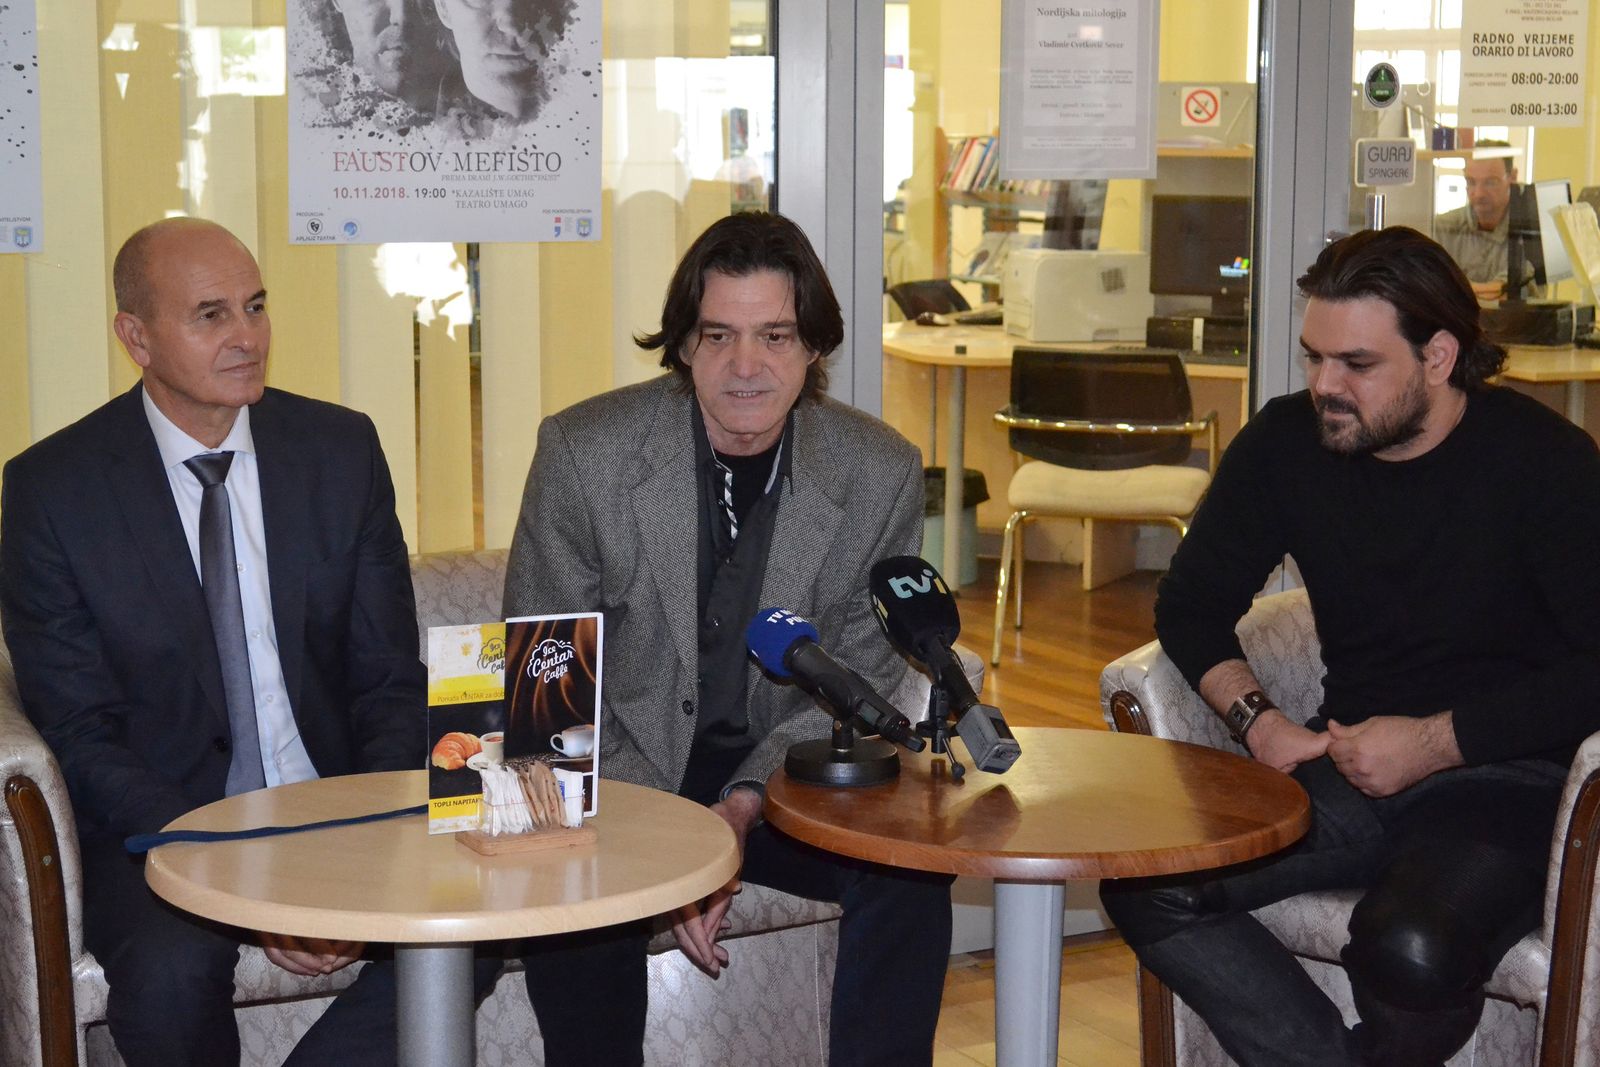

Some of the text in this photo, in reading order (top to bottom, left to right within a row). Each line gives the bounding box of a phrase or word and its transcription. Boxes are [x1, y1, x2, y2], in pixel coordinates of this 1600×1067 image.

[1473, 33, 1575, 45] RADNO VRIJEME
[1472, 46, 1574, 57] ORARIO DI LAVORO
[1511, 72, 1579, 85] 08:00-20:00
[1510, 103, 1578, 115] 08:00-13:00
[1367, 146, 1412, 162] GURAJ
[333, 151, 562, 172] FAUSTOV MEFISTO
[1368, 167, 1409, 178] SPINGERE
[333, 187, 447, 199] 10.11.2018. 19:00
[507, 189, 535, 198] UMAG
[456, 200, 528, 209] TEATRO UMAGO
[543, 644, 557, 658] Ice
[532, 649, 575, 678] Centar
[433, 801, 452, 809] TOPLI
